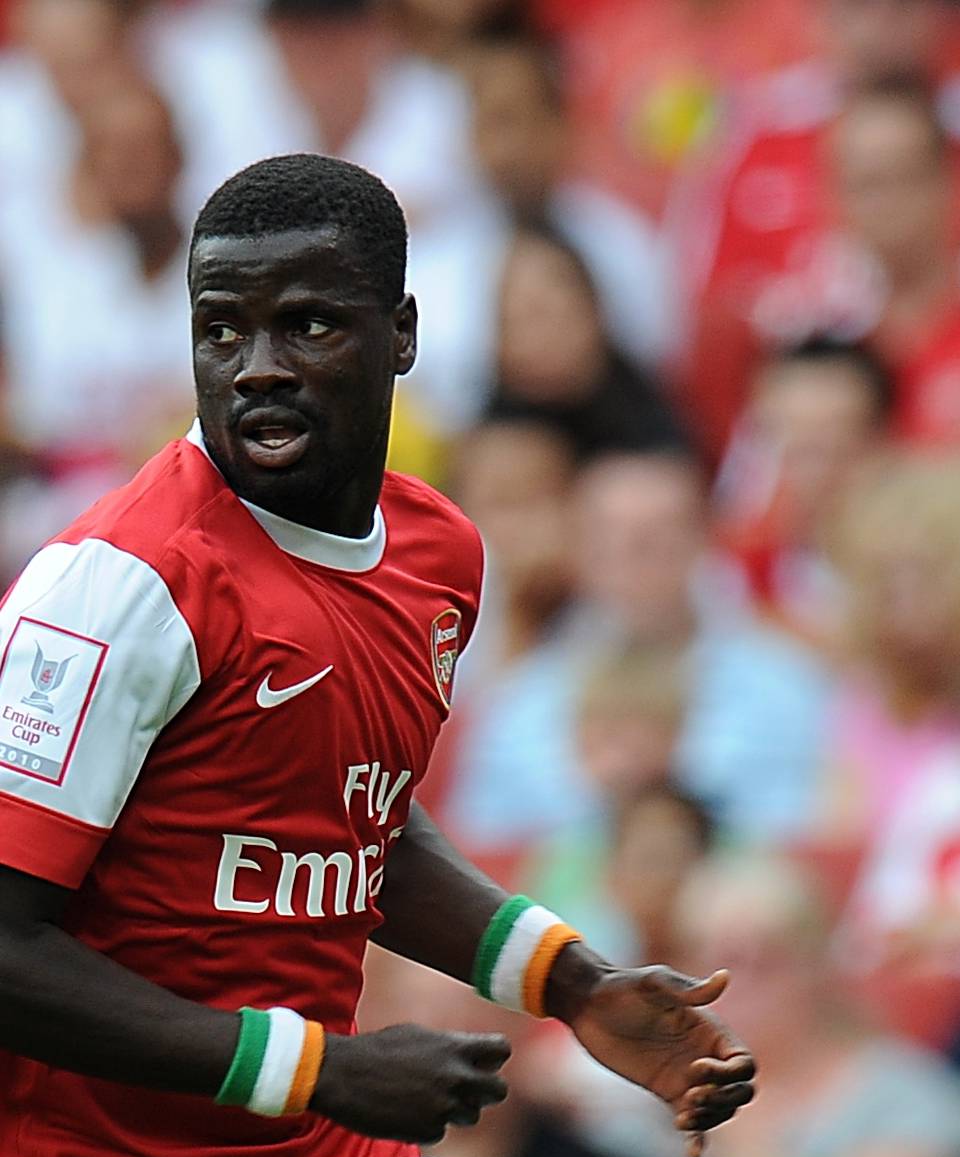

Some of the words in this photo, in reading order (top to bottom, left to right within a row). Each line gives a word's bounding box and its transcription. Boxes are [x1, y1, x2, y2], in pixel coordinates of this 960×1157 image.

[2, 705, 61, 737] Emirates
[12, 725, 41, 746] Cup
[0, 746, 41, 770] 2010
[343, 761, 412, 826] Fly
